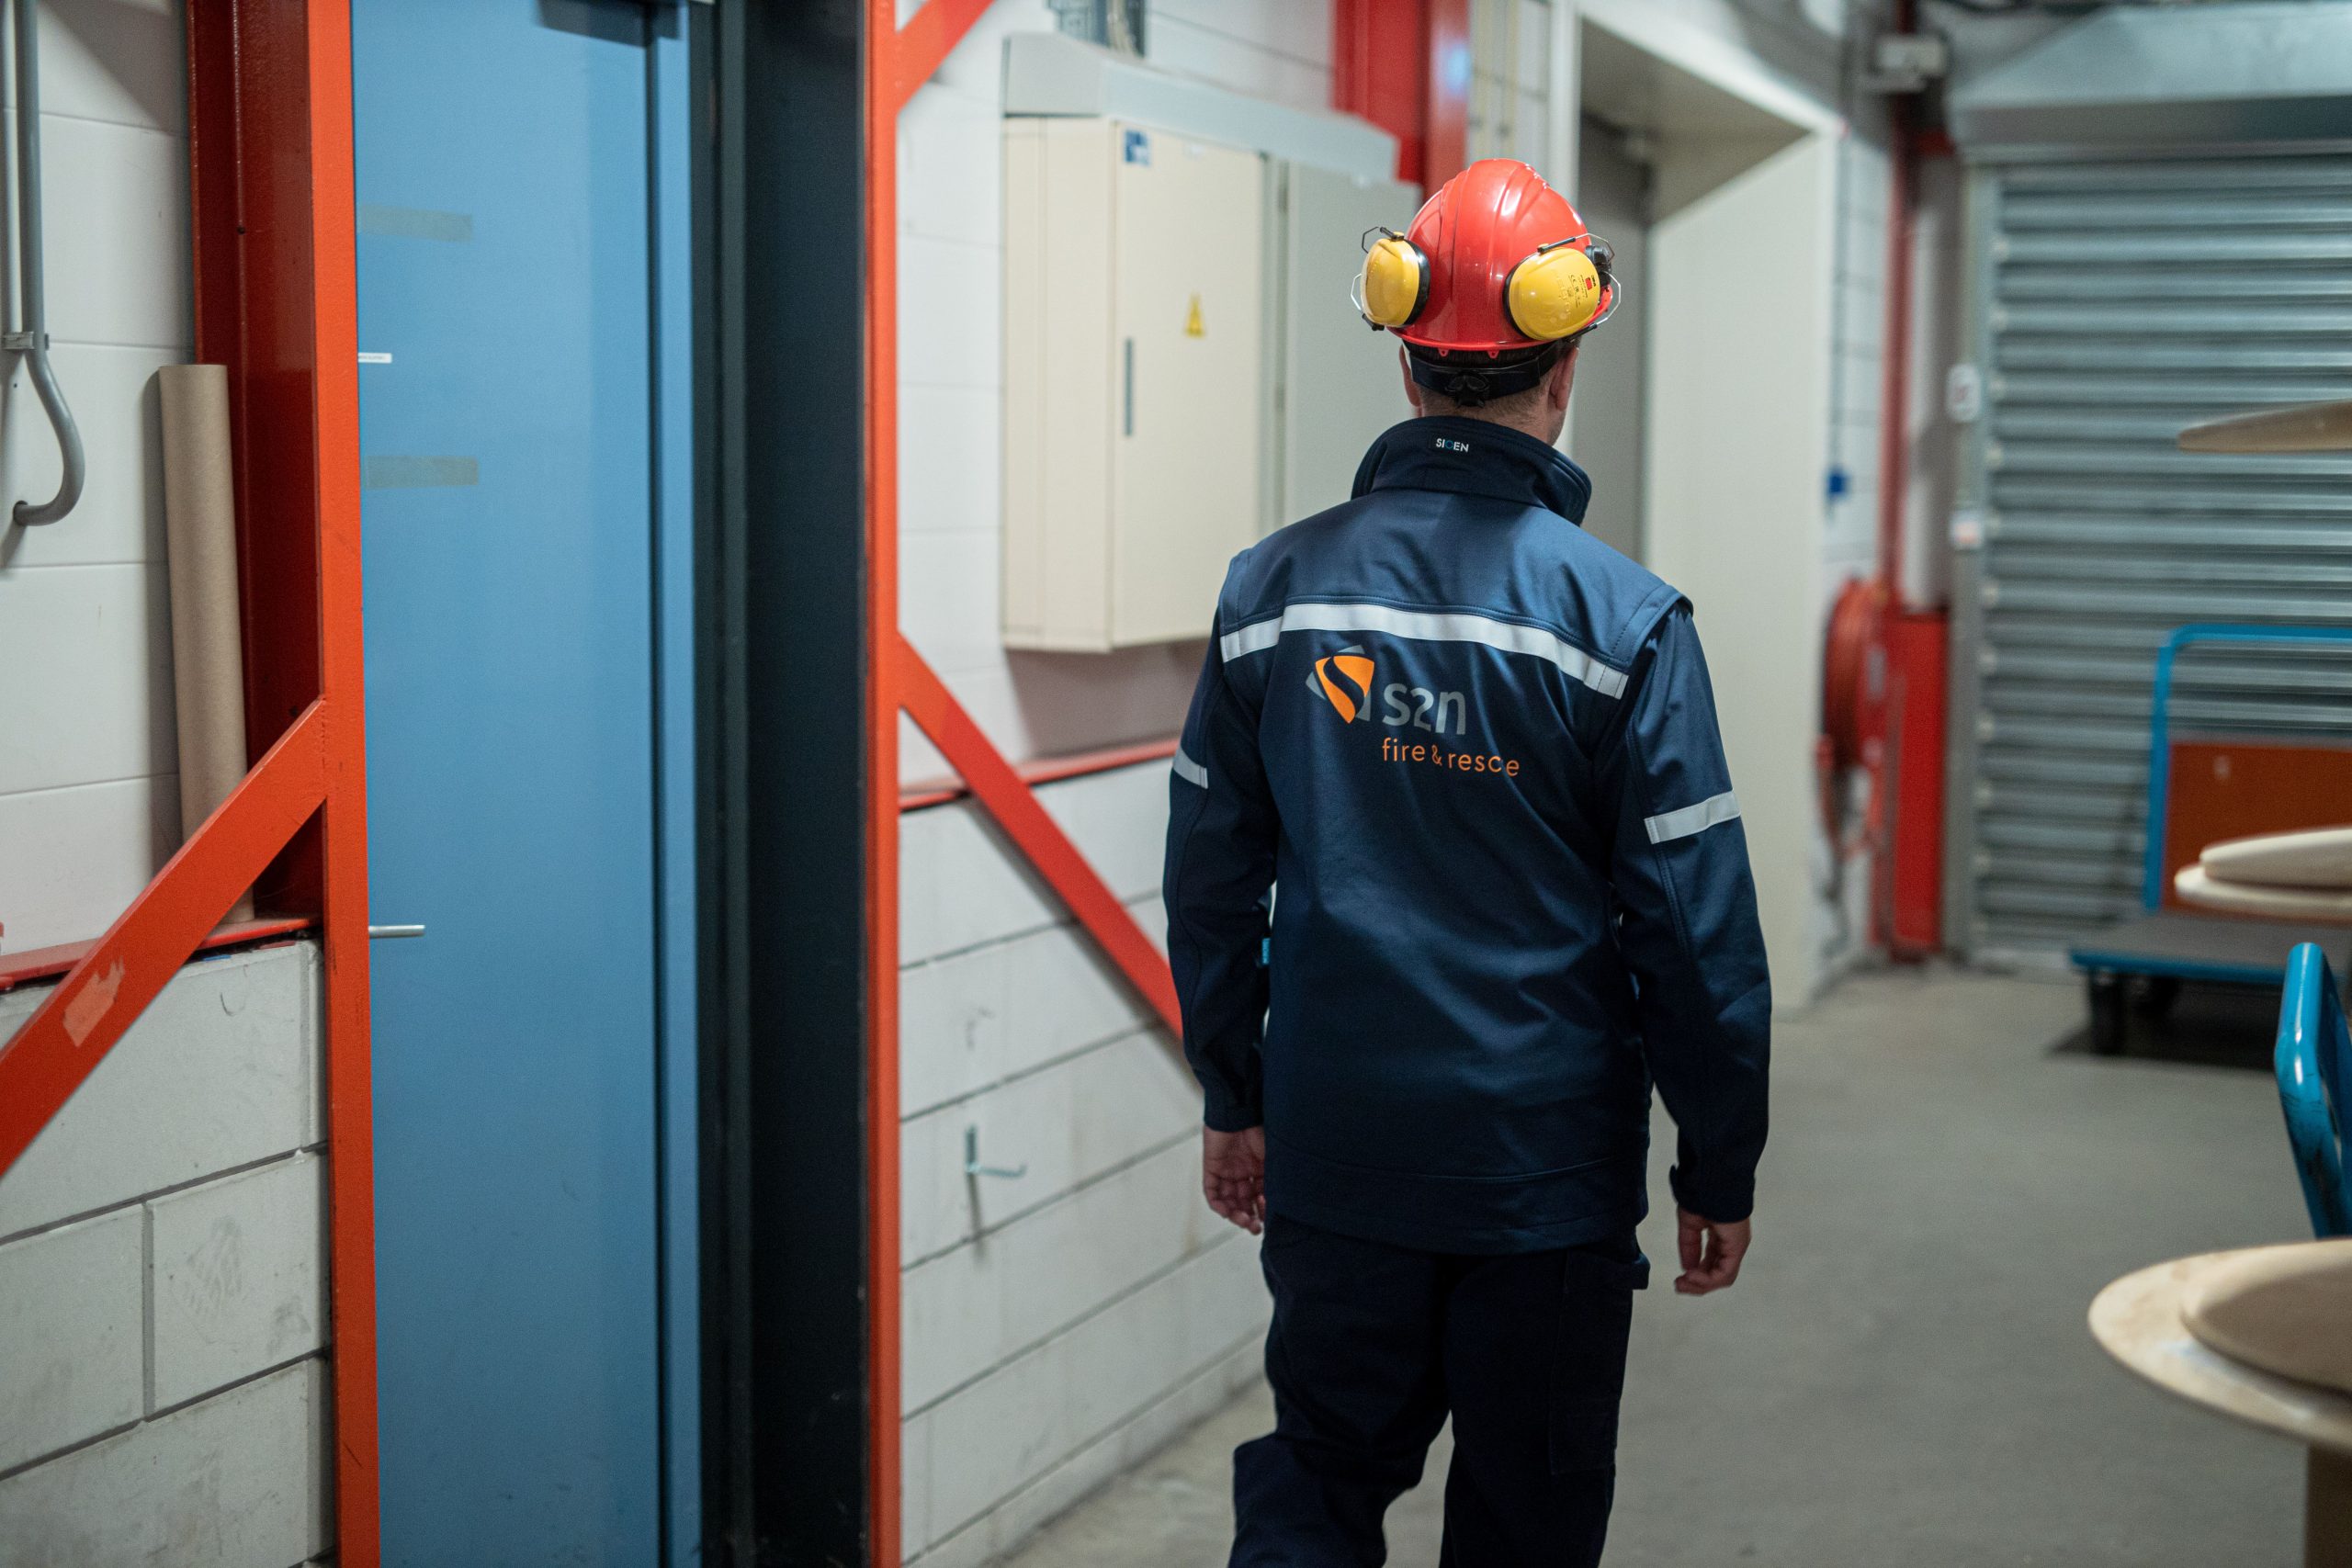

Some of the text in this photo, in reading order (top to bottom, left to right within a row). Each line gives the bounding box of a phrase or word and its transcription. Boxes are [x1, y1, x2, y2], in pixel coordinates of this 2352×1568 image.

[1435, 437, 1470, 453] SIOEN
[1381, 737, 1426, 762] fire
[1431, 744, 1443, 767] &
